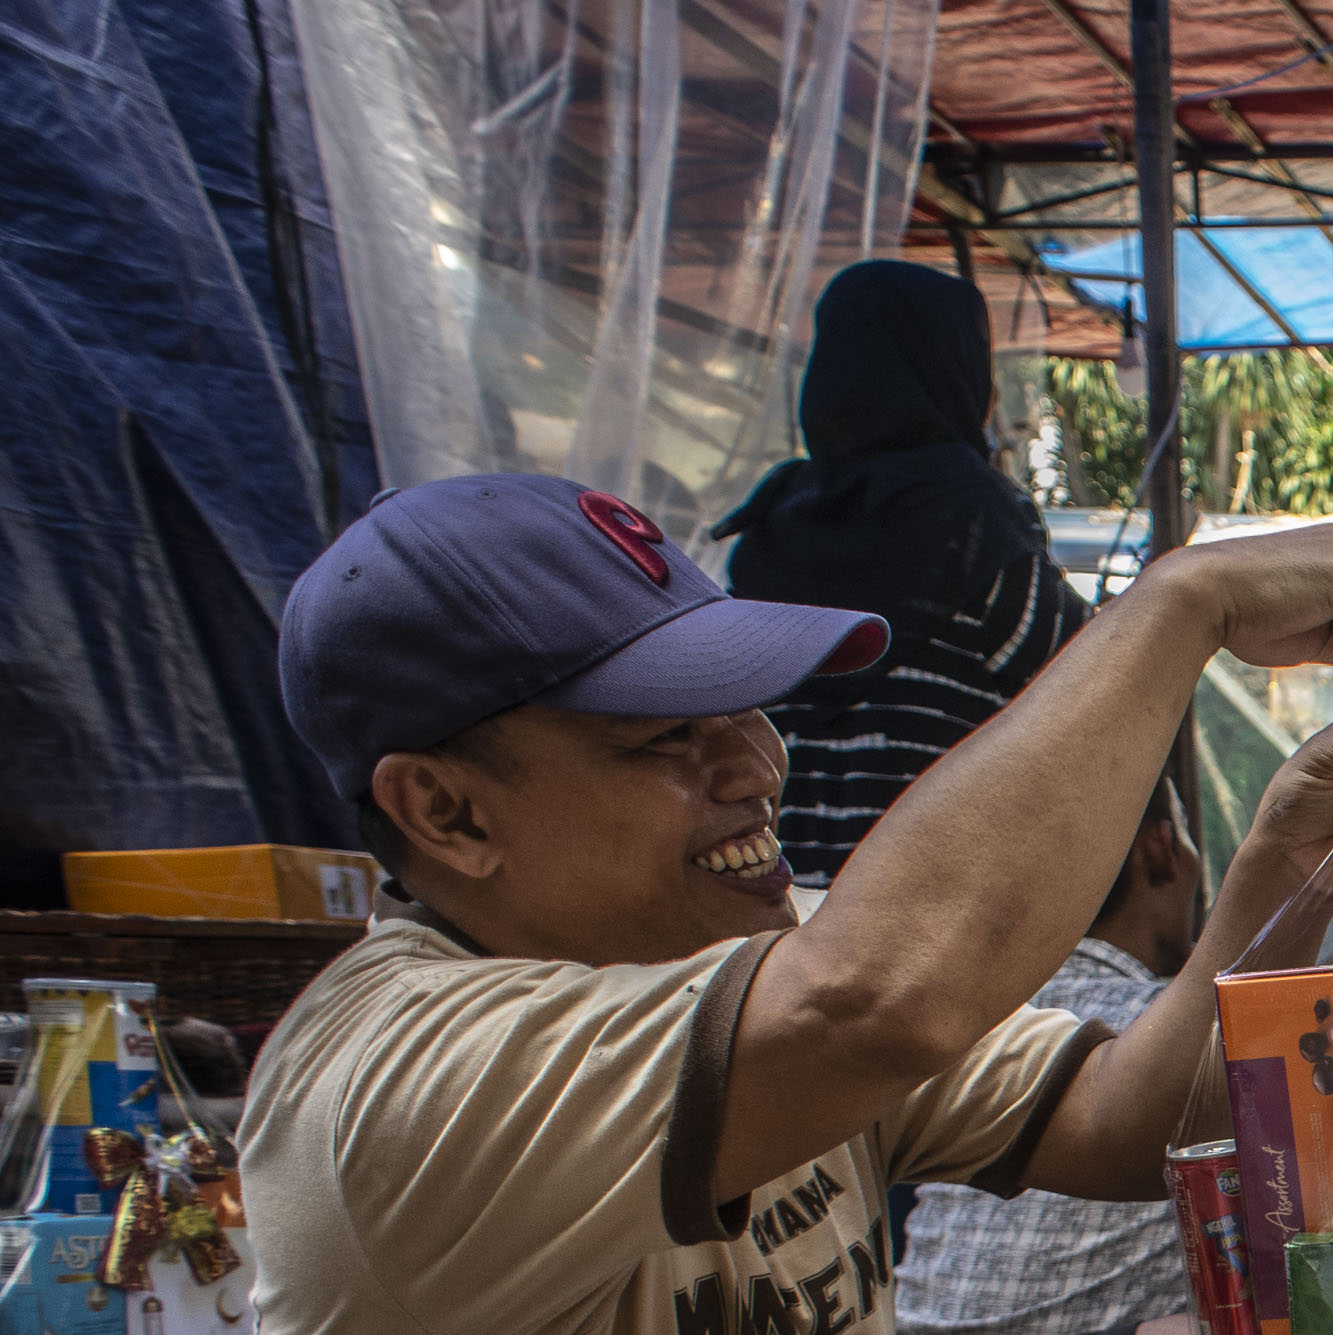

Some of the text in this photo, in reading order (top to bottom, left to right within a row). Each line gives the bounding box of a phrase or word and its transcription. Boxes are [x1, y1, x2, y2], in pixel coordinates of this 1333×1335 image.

[1215, 1174, 1240, 1193] FAN
[1271, 1141, 1304, 1236] Assortment
[50, 1235, 108, 1270] AST
